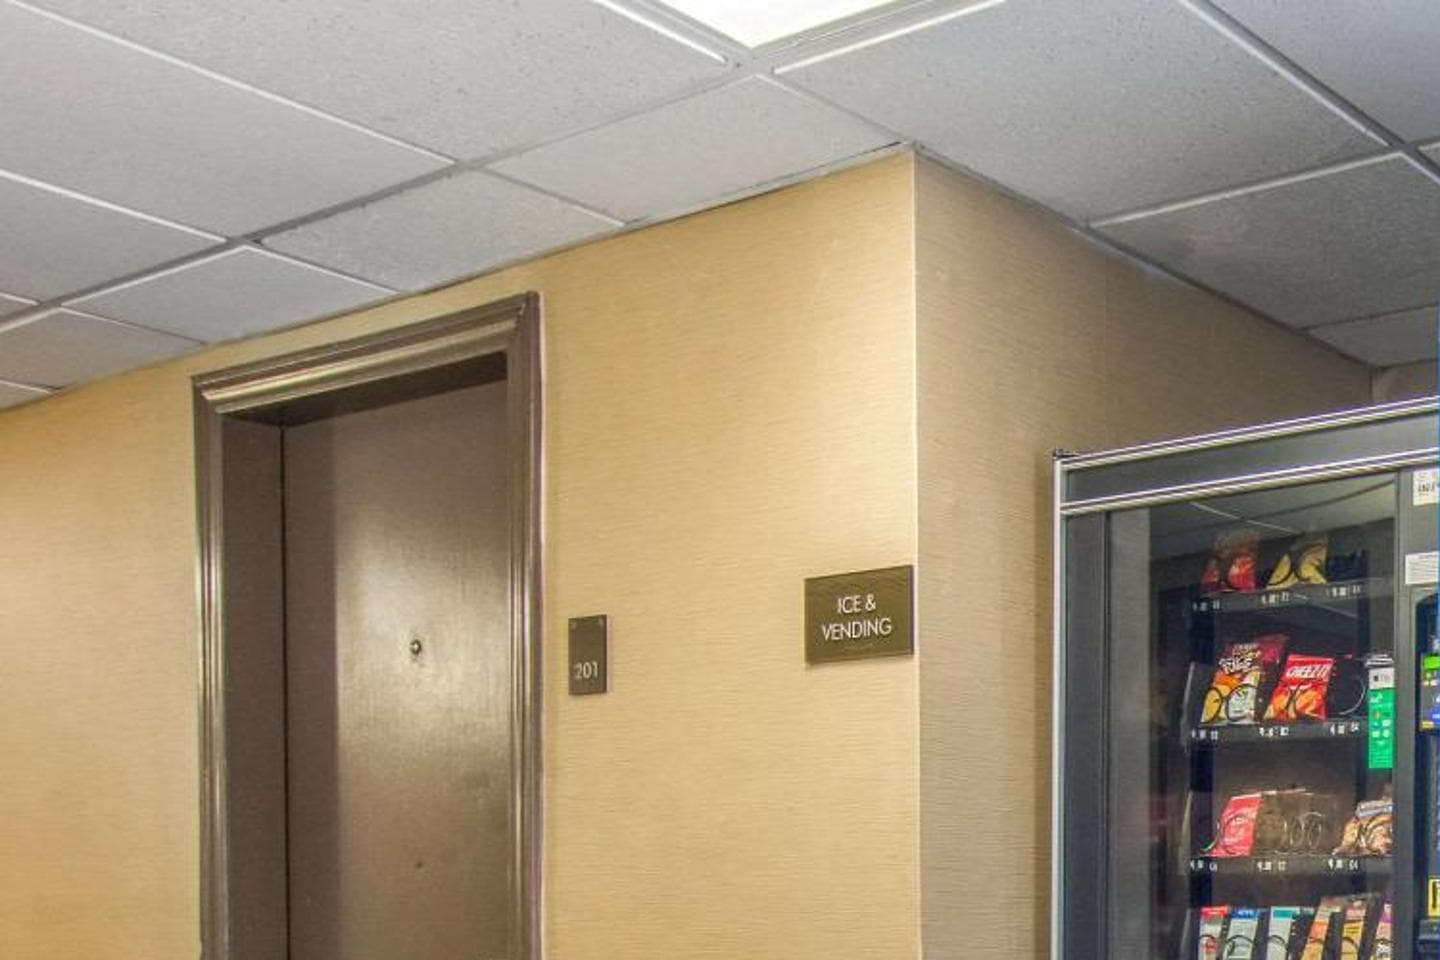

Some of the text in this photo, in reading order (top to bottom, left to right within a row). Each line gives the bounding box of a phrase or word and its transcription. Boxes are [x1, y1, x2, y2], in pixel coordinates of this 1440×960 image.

[837, 592, 877, 614] ICE &
[821, 616, 892, 641] VENDING
[573, 661, 599, 680] 201
